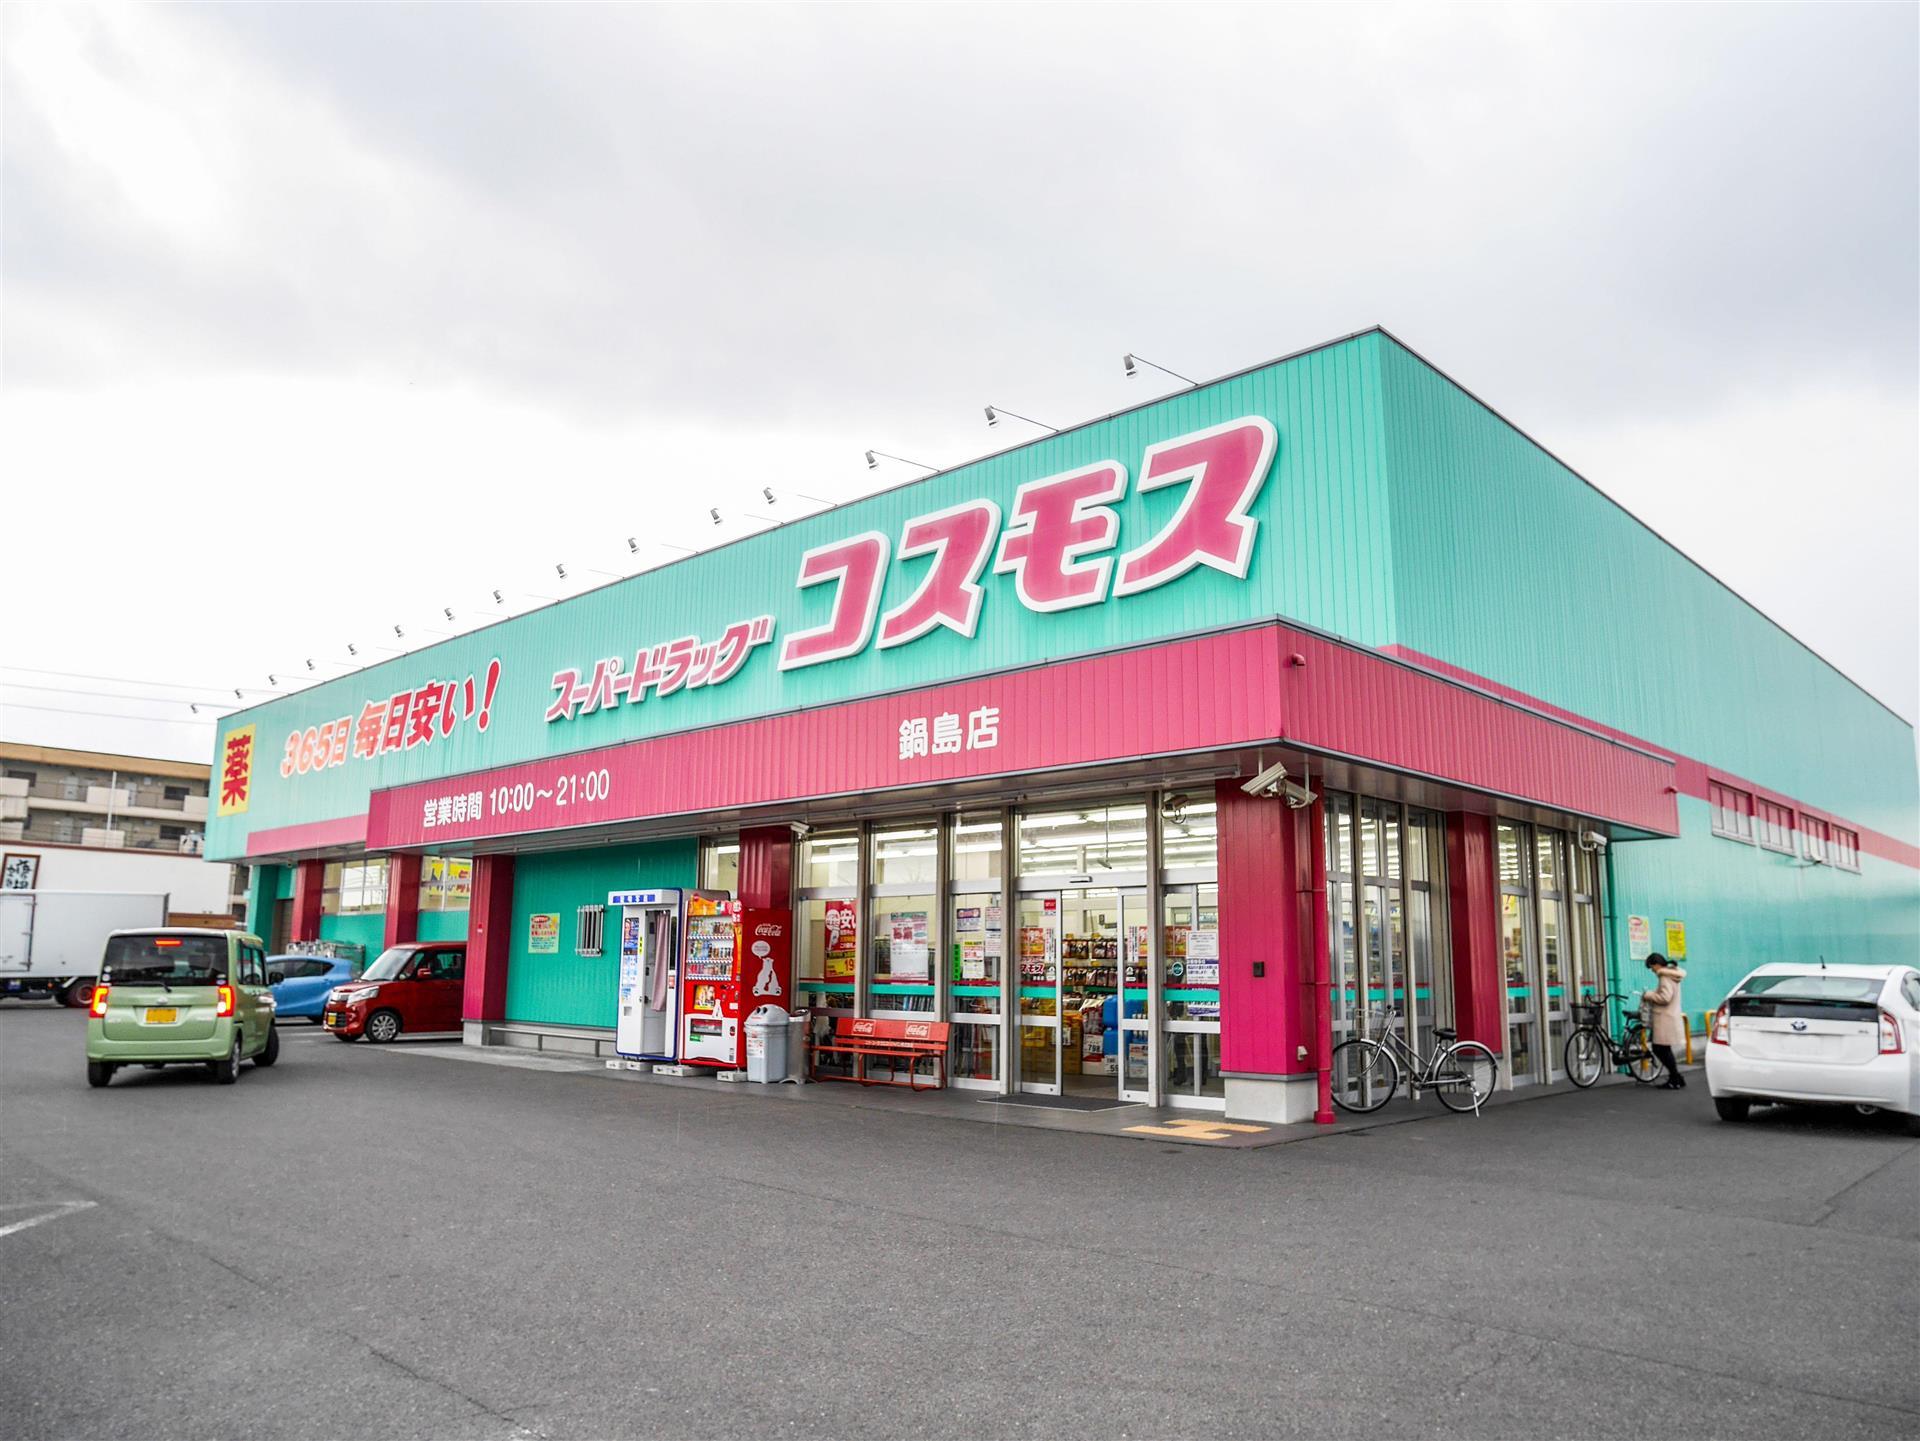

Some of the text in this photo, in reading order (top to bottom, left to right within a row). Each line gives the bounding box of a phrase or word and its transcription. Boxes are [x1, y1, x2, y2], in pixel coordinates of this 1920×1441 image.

[544, 415, 1278, 722] スーパードラッグ コスモス
[280, 715, 352, 778] 365日
[899, 705, 1000, 760] 鍋島店
[222, 734, 252, 806] 薬
[423, 791, 483, 828] 営業時間
[755, 923, 782, 937] Coca-Cola
